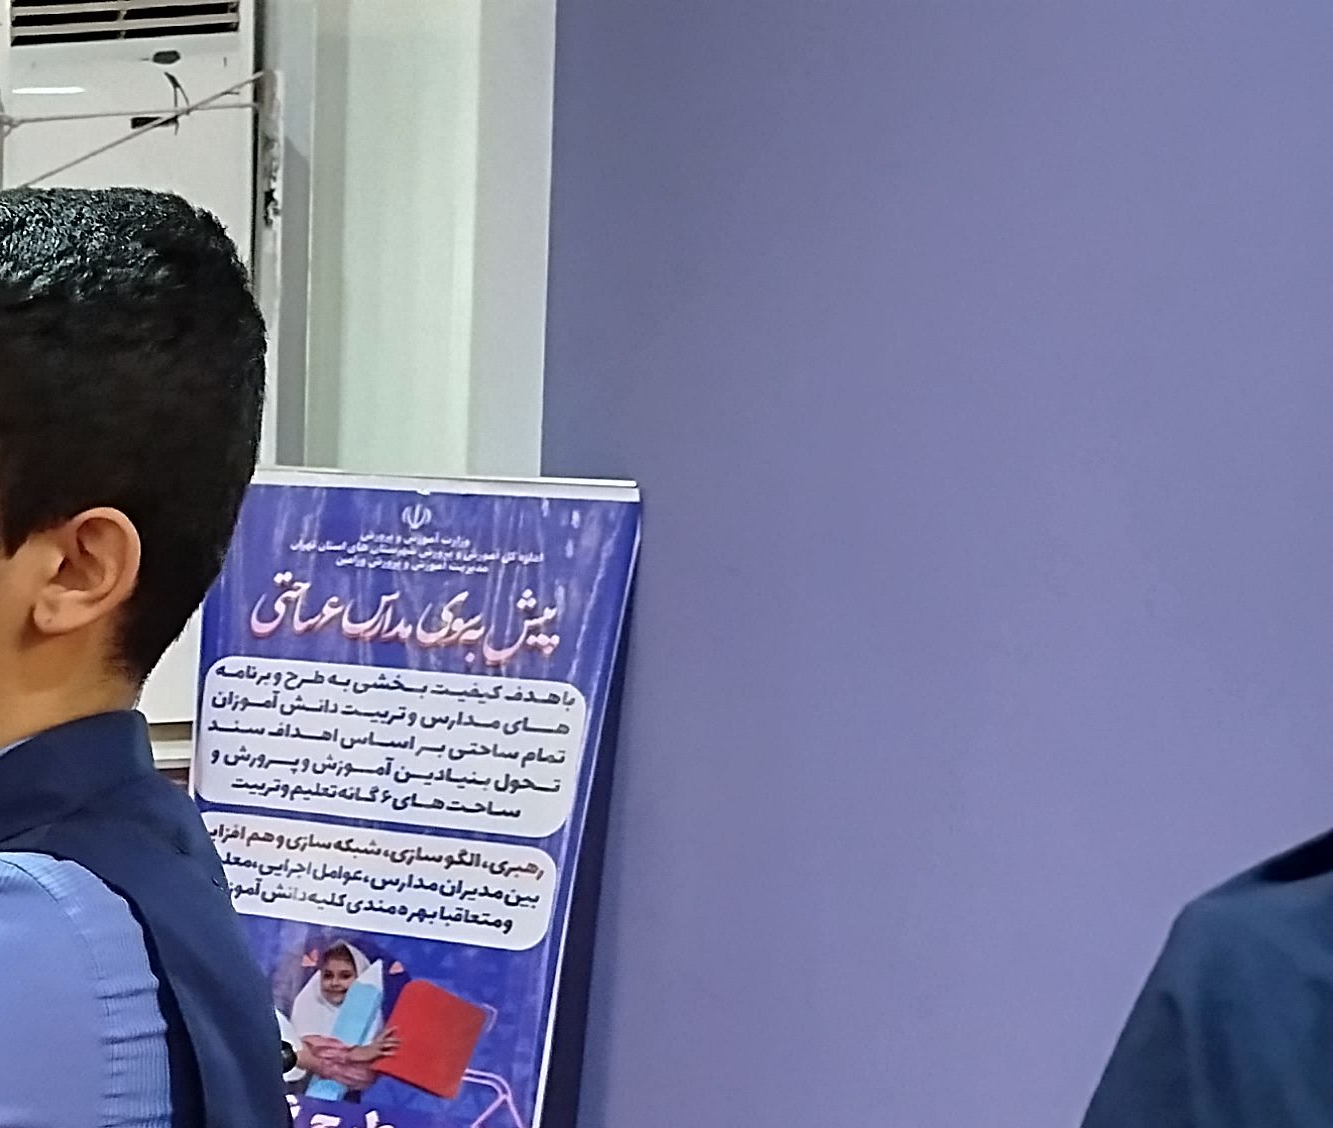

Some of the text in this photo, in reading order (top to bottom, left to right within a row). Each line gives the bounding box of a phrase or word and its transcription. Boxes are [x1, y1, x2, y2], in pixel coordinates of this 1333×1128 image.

[483, 588, 560, 667] پیش
[284, 670, 325, 690] طرح
[328, 674, 351, 692] به
[352, 673, 428, 697] بخشی
[211, 690, 280, 711] آموزان
[430, 683, 503, 704] کیفیت
[279, 695, 338, 715] دانش
[340, 703, 406, 725] تربیت
[420, 711, 501, 731] مدارس
[502, 717, 570, 735] های
[207, 719, 566, 768] تمام ساحتی بر اساس اهداف سند
[210, 749, 220, 764] و
[312, 754, 394, 777] آموزش
[393, 766, 491, 790] بنیادین
[494, 773, 561, 793] تحول
[289, 782, 338, 800] تعلیم
[338, 786, 379, 802] گانه
[391, 792, 445, 811] های
[446, 800, 521, 818] ساحت
[286, 833, 332, 851] سازی
[312, 863, 362, 886] عوامل
[439, 878, 504, 901] مدیران
[504, 889, 540, 909] بین
[308, 892, 347, 910] کلیه
